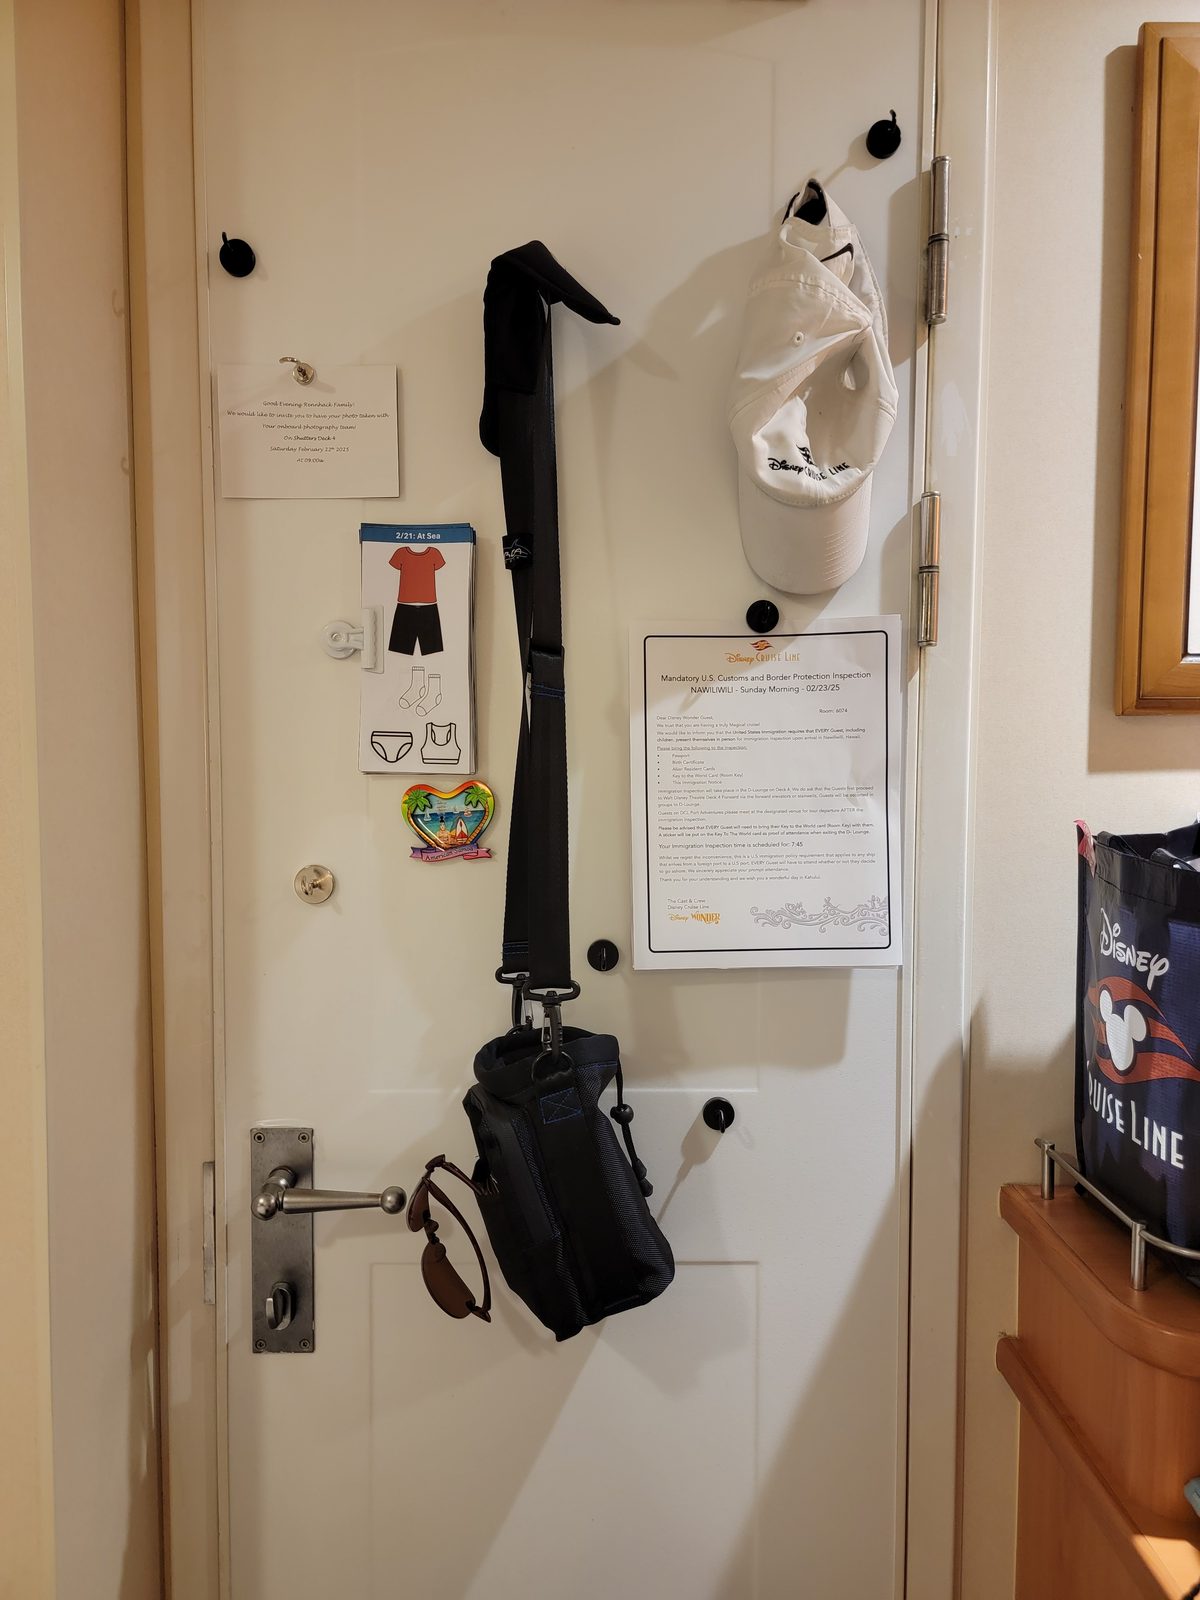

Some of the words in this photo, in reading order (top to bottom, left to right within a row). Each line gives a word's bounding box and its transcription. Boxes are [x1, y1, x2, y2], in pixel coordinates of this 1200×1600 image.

[661, 675, 701, 684] Mandatory
[832, 672, 871, 681] Inspection
[740, 686, 768, 694] Sunday
[768, 685, 800, 694] Morning
[1087, 1060, 1125, 1134] RUISE
[1130, 1100, 1184, 1170] LINE
